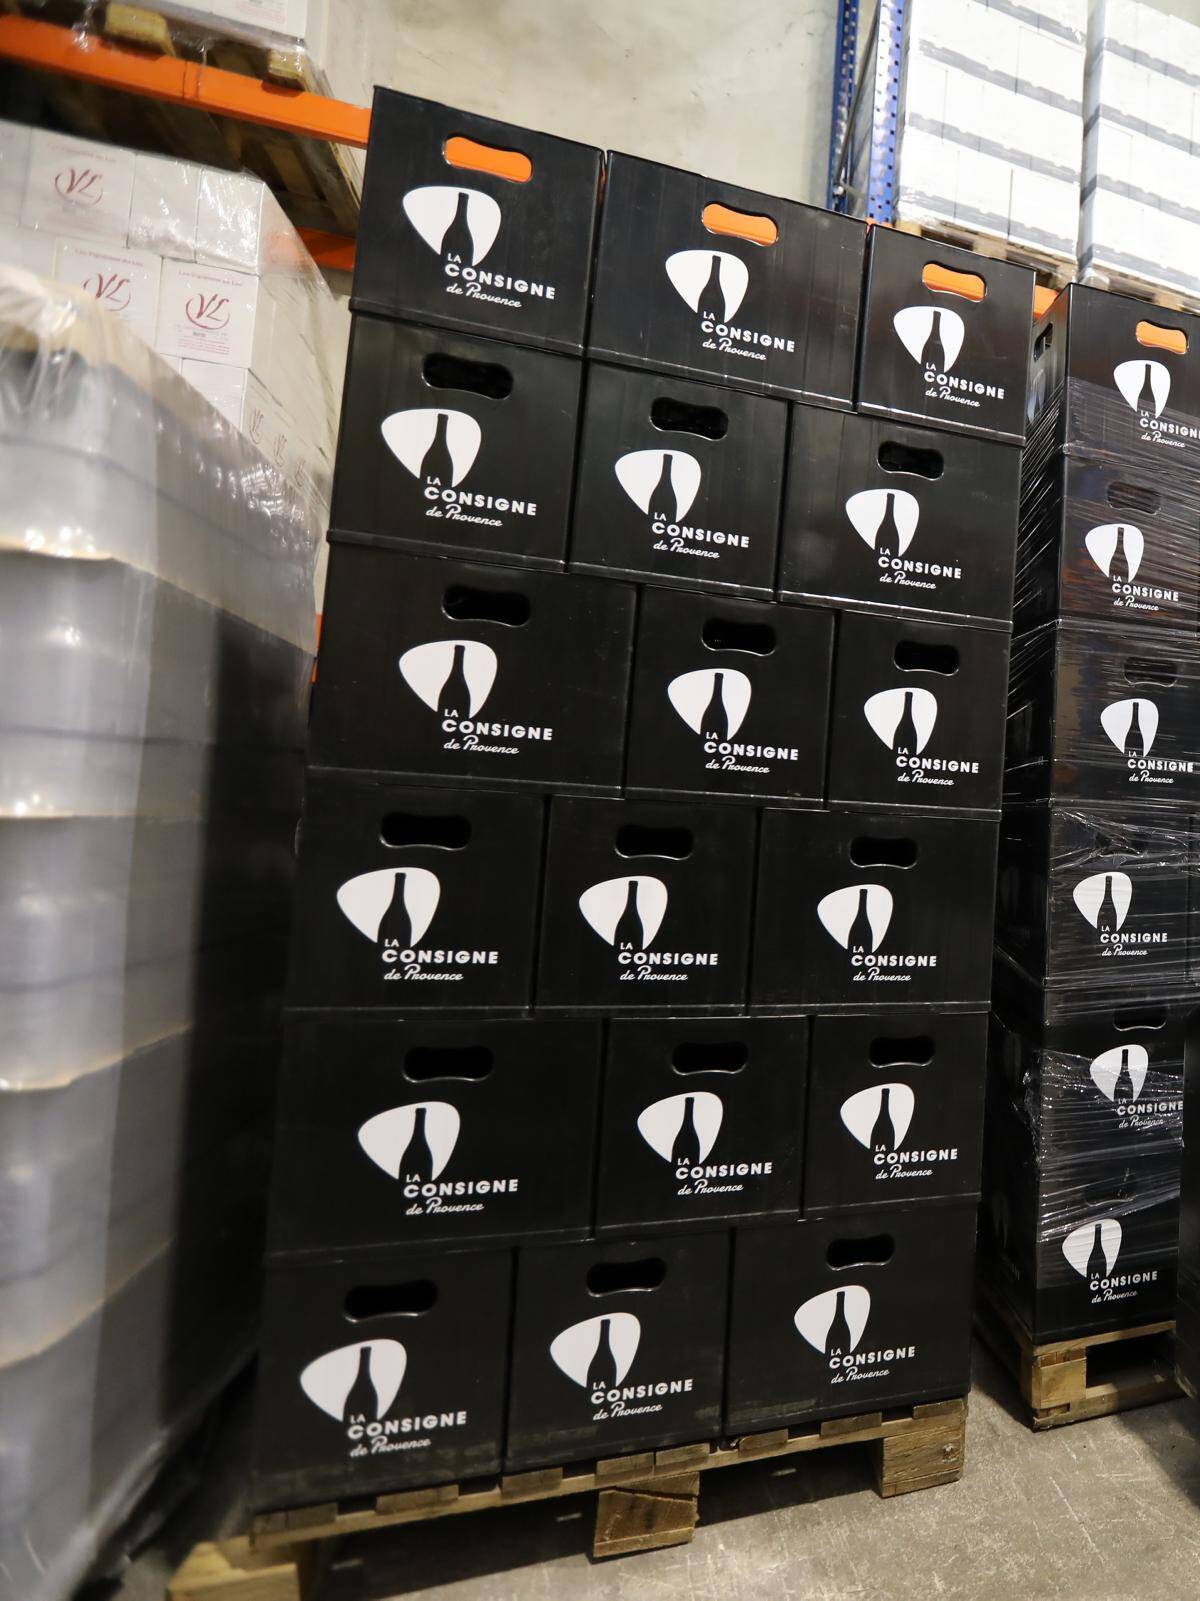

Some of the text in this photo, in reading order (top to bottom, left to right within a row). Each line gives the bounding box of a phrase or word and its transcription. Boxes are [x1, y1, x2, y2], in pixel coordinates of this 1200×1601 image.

[448, 253, 461, 263] LA
[445, 263, 555, 300] CONSIGNE
[446, 282, 522, 308] de Provence
[703, 311, 715, 321] LA
[701, 321, 795, 352] CONSIGNE
[702, 337, 766, 360] de Provence
[926, 362, 936, 371] LA
[924, 371, 1004, 399] CONSIGNE
[925, 386, 980, 407] de Provence
[427, 476, 441, 486] LA
[424, 487, 537, 516] CONSIGNE
[426, 504, 502, 527] de Provence
[654, 512, 666, 521] LA
[652, 522, 749, 548] CONSIGNE
[653, 537, 720, 558] de Provence
[880, 547, 890, 555] LA
[878, 556, 961, 579] CONSIGNE
[879, 570, 936, 589] de Provence
[1112, 583, 1178, 602] CONSIGNE
[445, 709, 458, 718] LA
[442, 719, 552, 741] CONSIGNE
[706, 732, 718, 740] LA
[444, 735, 519, 754] de Provence
[704, 741, 798, 761] CONSIGNE
[898, 747, 908, 755] LA
[705, 755, 770, 773] de Provence
[896, 756, 979, 774] CONSIGNE
[1127, 759, 1193, 772] CONSIGNE
[897, 769, 954, 785] de Provence
[385, 939, 399, 947] LA
[620, 942, 633, 950] LA
[1100, 933, 1167, 945] CONSIGNE
[382, 950, 498, 965] CONSIGNE
[618, 952, 718, 967] CONSIGNE
[851, 955, 937, 968] CONSIGNE
[384, 964, 463, 980] de Provence
[620, 965, 688, 980] de Provence
[853, 967, 911, 981] de Provence
[1116, 1100, 1183, 1116] CONSIGNE
[875, 1144, 886, 1152] LA
[678, 1157, 690, 1166] LA
[874, 1149, 958, 1165] CONSIGNE
[406, 1174, 420, 1183] LA
[675, 1162, 772, 1180] CONSIGNE
[875, 1164, 933, 1179] de Provence
[403, 1179, 518, 1199] CONSIGNE
[677, 1179, 743, 1195] de Provence
[406, 1197, 484, 1215] de Provence
[1090, 1271, 1157, 1290] CONSIGNE
[829, 1346, 915, 1369] CONSIGNE
[831, 1348, 842, 1356] LA
[831, 1366, 890, 1383] de Provence
[591, 1379, 693, 1404] CONSIGNE
[593, 1381, 606, 1390] LA
[593, 1401, 662, 1420] de Provence
[348, 1411, 467, 1439] CONSIGNE
[351, 1414, 365, 1424] LA
[350, 1436, 431, 1456] de Provence
